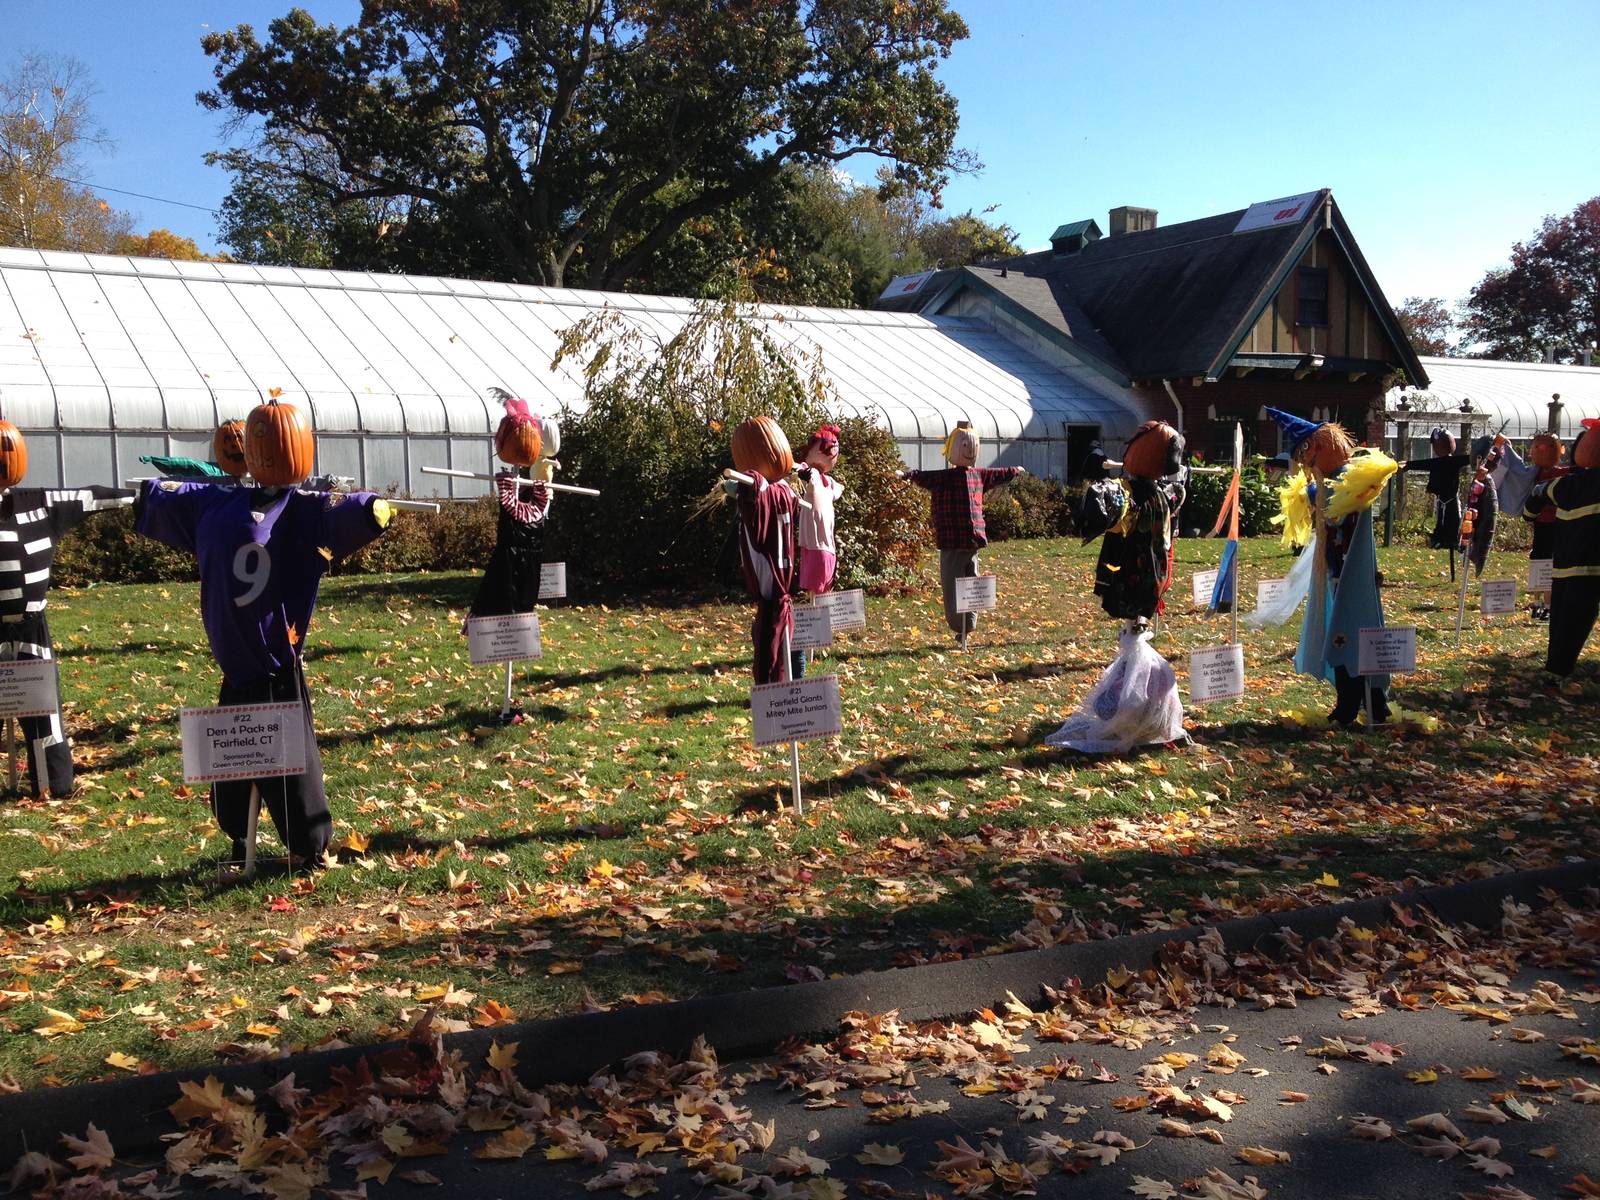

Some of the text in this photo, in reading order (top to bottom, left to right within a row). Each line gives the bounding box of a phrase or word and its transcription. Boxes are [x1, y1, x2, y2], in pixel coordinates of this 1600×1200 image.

[232, 543, 271, 608] 9
[770, 695, 823, 708] Fairfield Giants
[788, 707, 803, 715] Mite
[805, 704, 828, 712] Juniors
[233, 714, 251, 723] #22
[206, 728, 227, 737] Den
[239, 724, 265, 734] Pack
[267, 723, 279, 732] 88
[213, 736, 273, 749] Fairfield, CT
